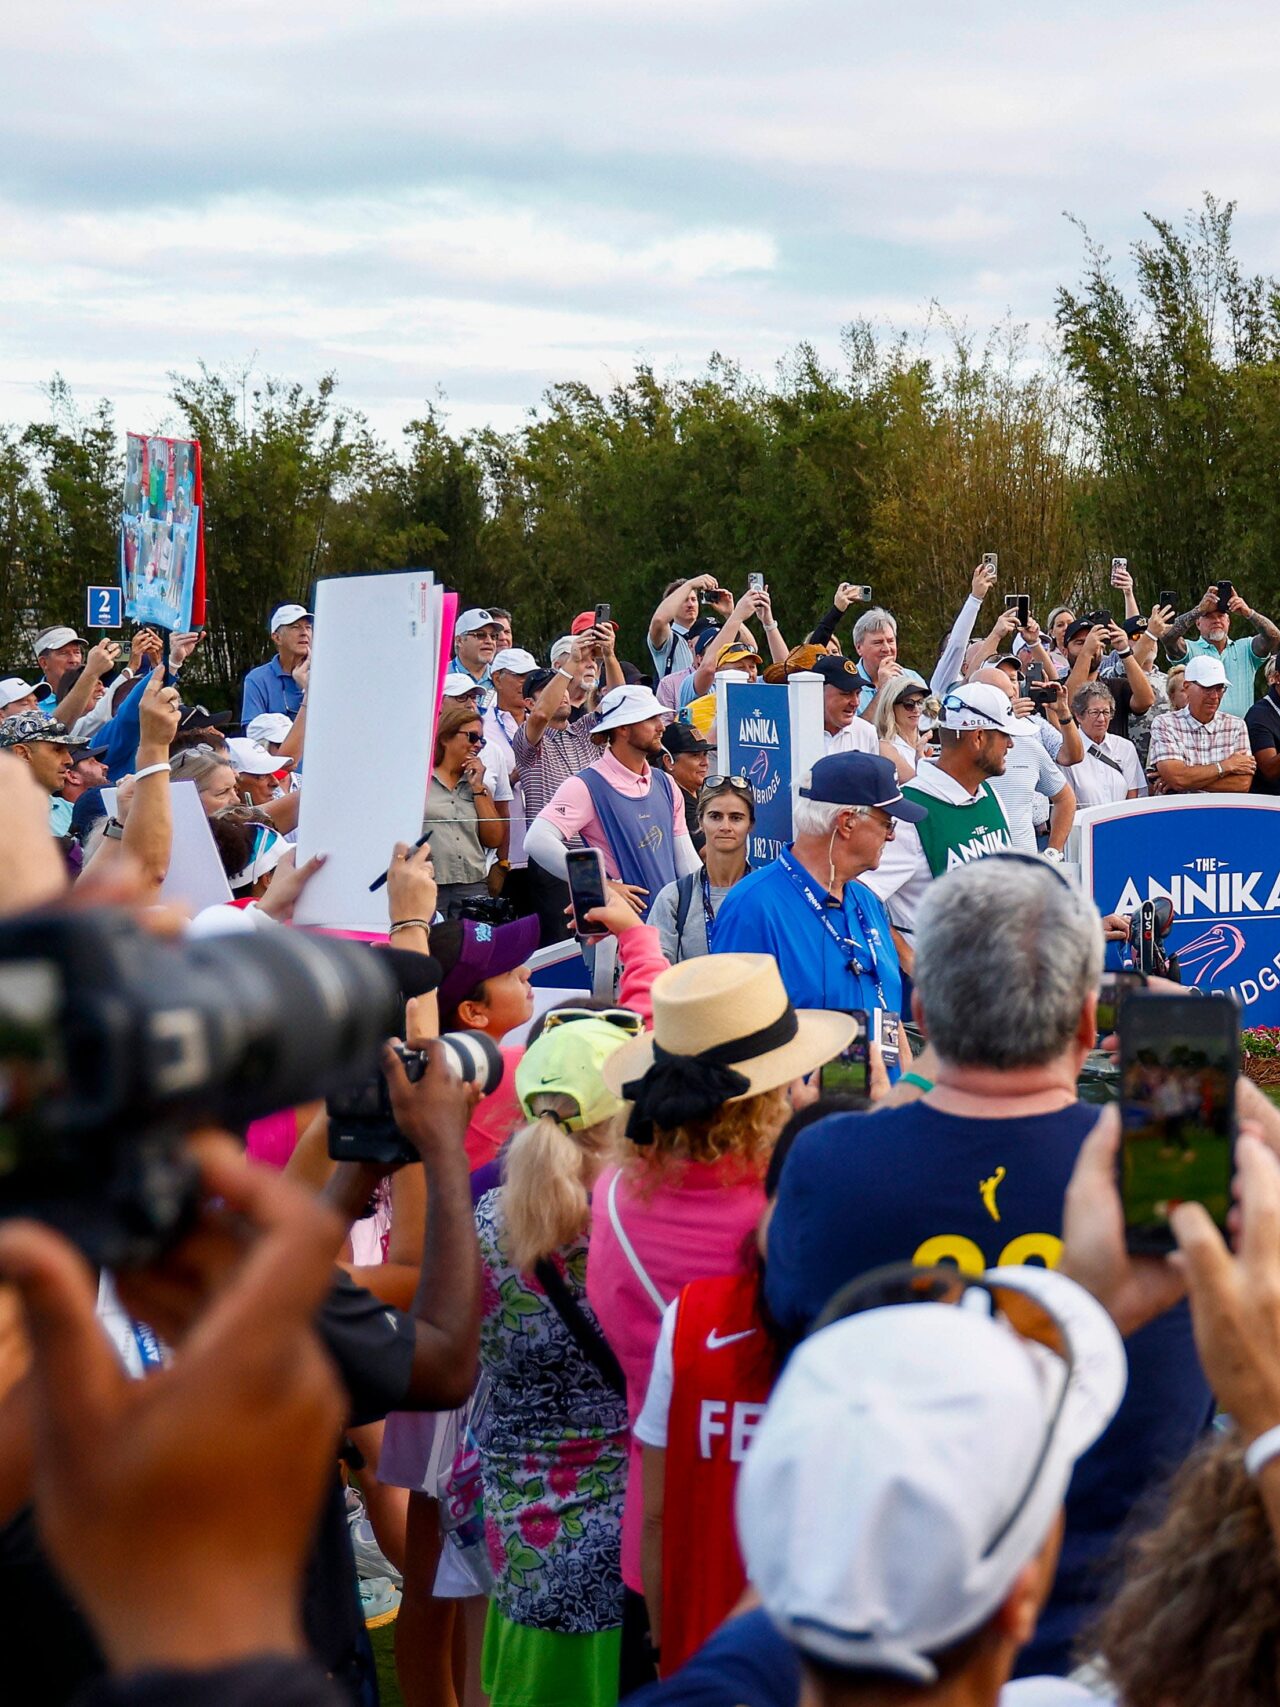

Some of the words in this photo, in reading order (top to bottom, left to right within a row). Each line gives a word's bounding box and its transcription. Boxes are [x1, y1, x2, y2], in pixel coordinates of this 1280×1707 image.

[99, 590, 110, 612] 2
[739, 718, 779, 745] ANNIKA
[753, 837, 767, 859] 182
[1196, 857, 1216, 871] THE
